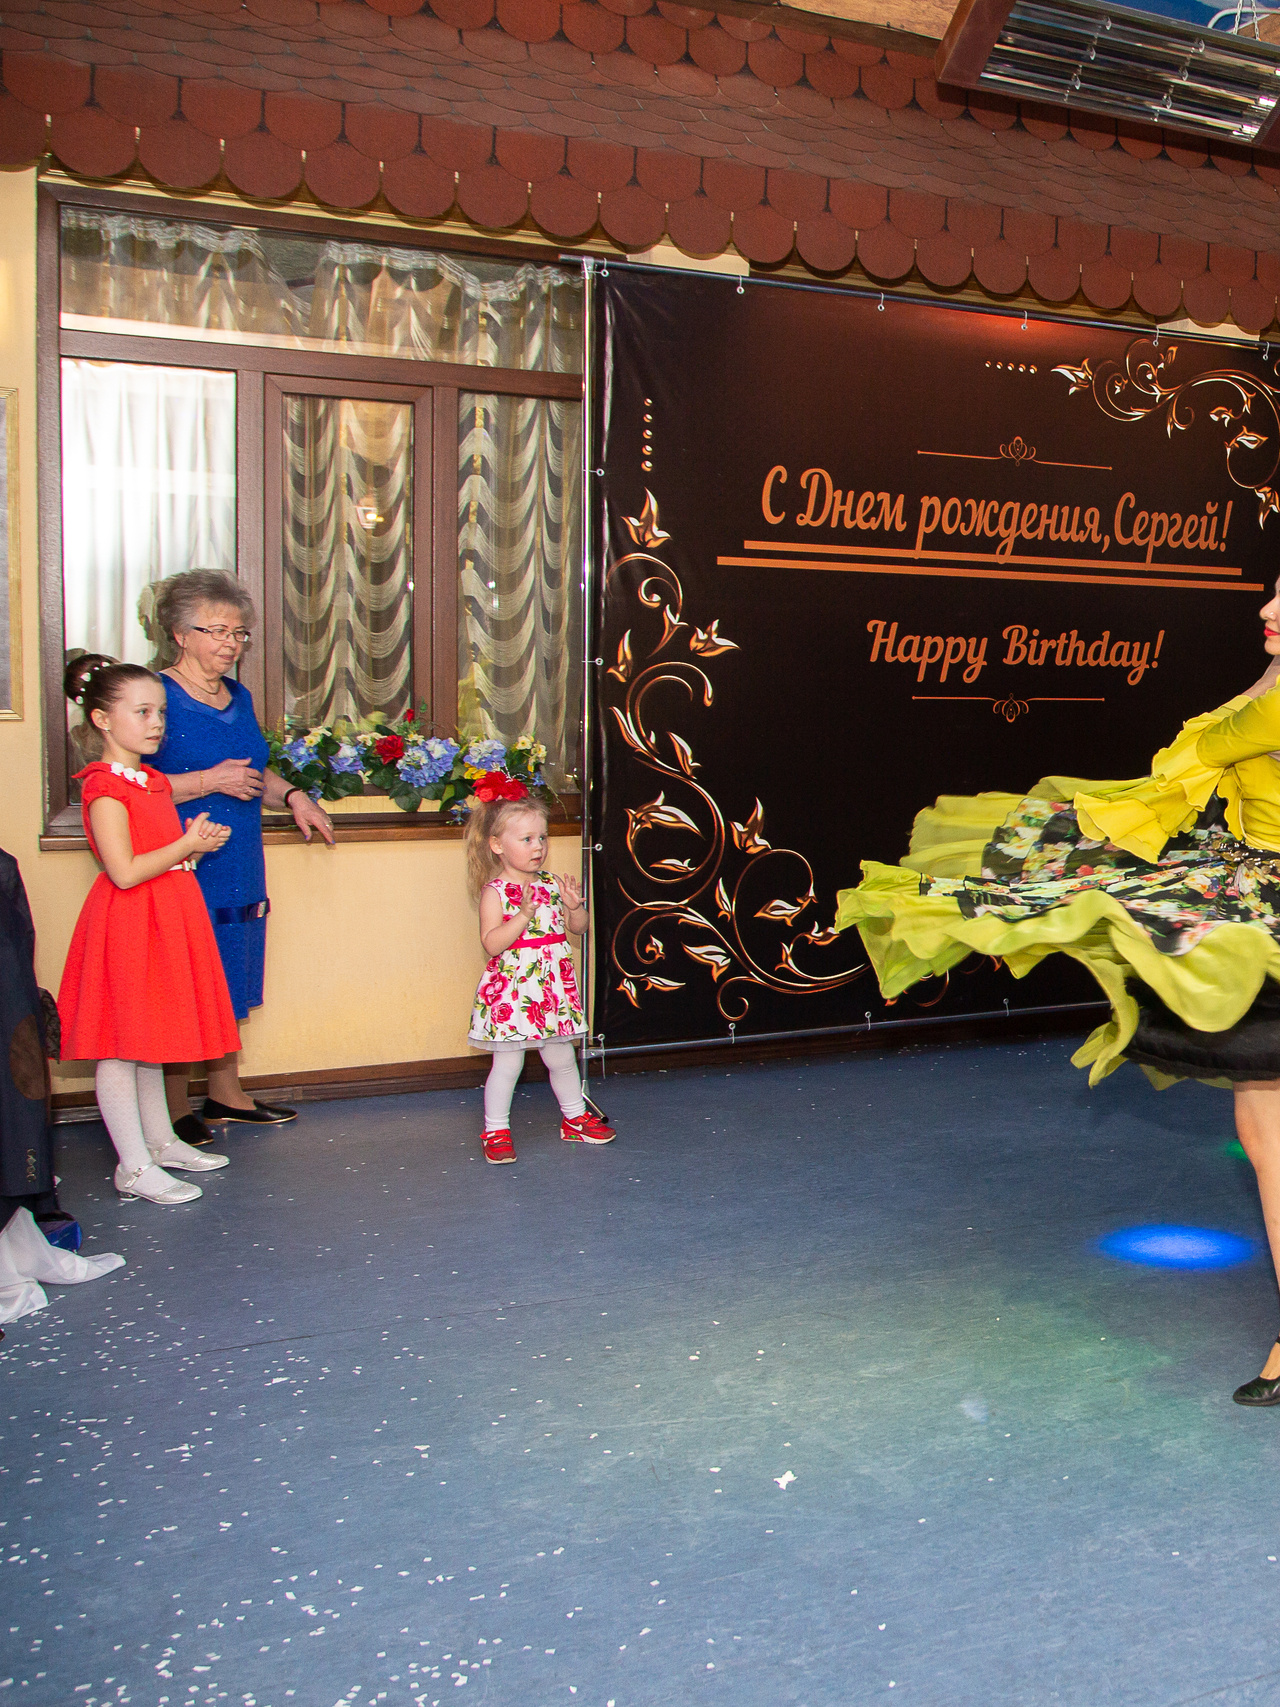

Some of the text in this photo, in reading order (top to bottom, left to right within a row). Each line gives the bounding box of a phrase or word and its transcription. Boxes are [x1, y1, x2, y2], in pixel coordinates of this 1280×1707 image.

[761, 464, 1234, 571] С Днем рождения, Сергей!
[867, 619, 1165, 686] Happy Birthday!
